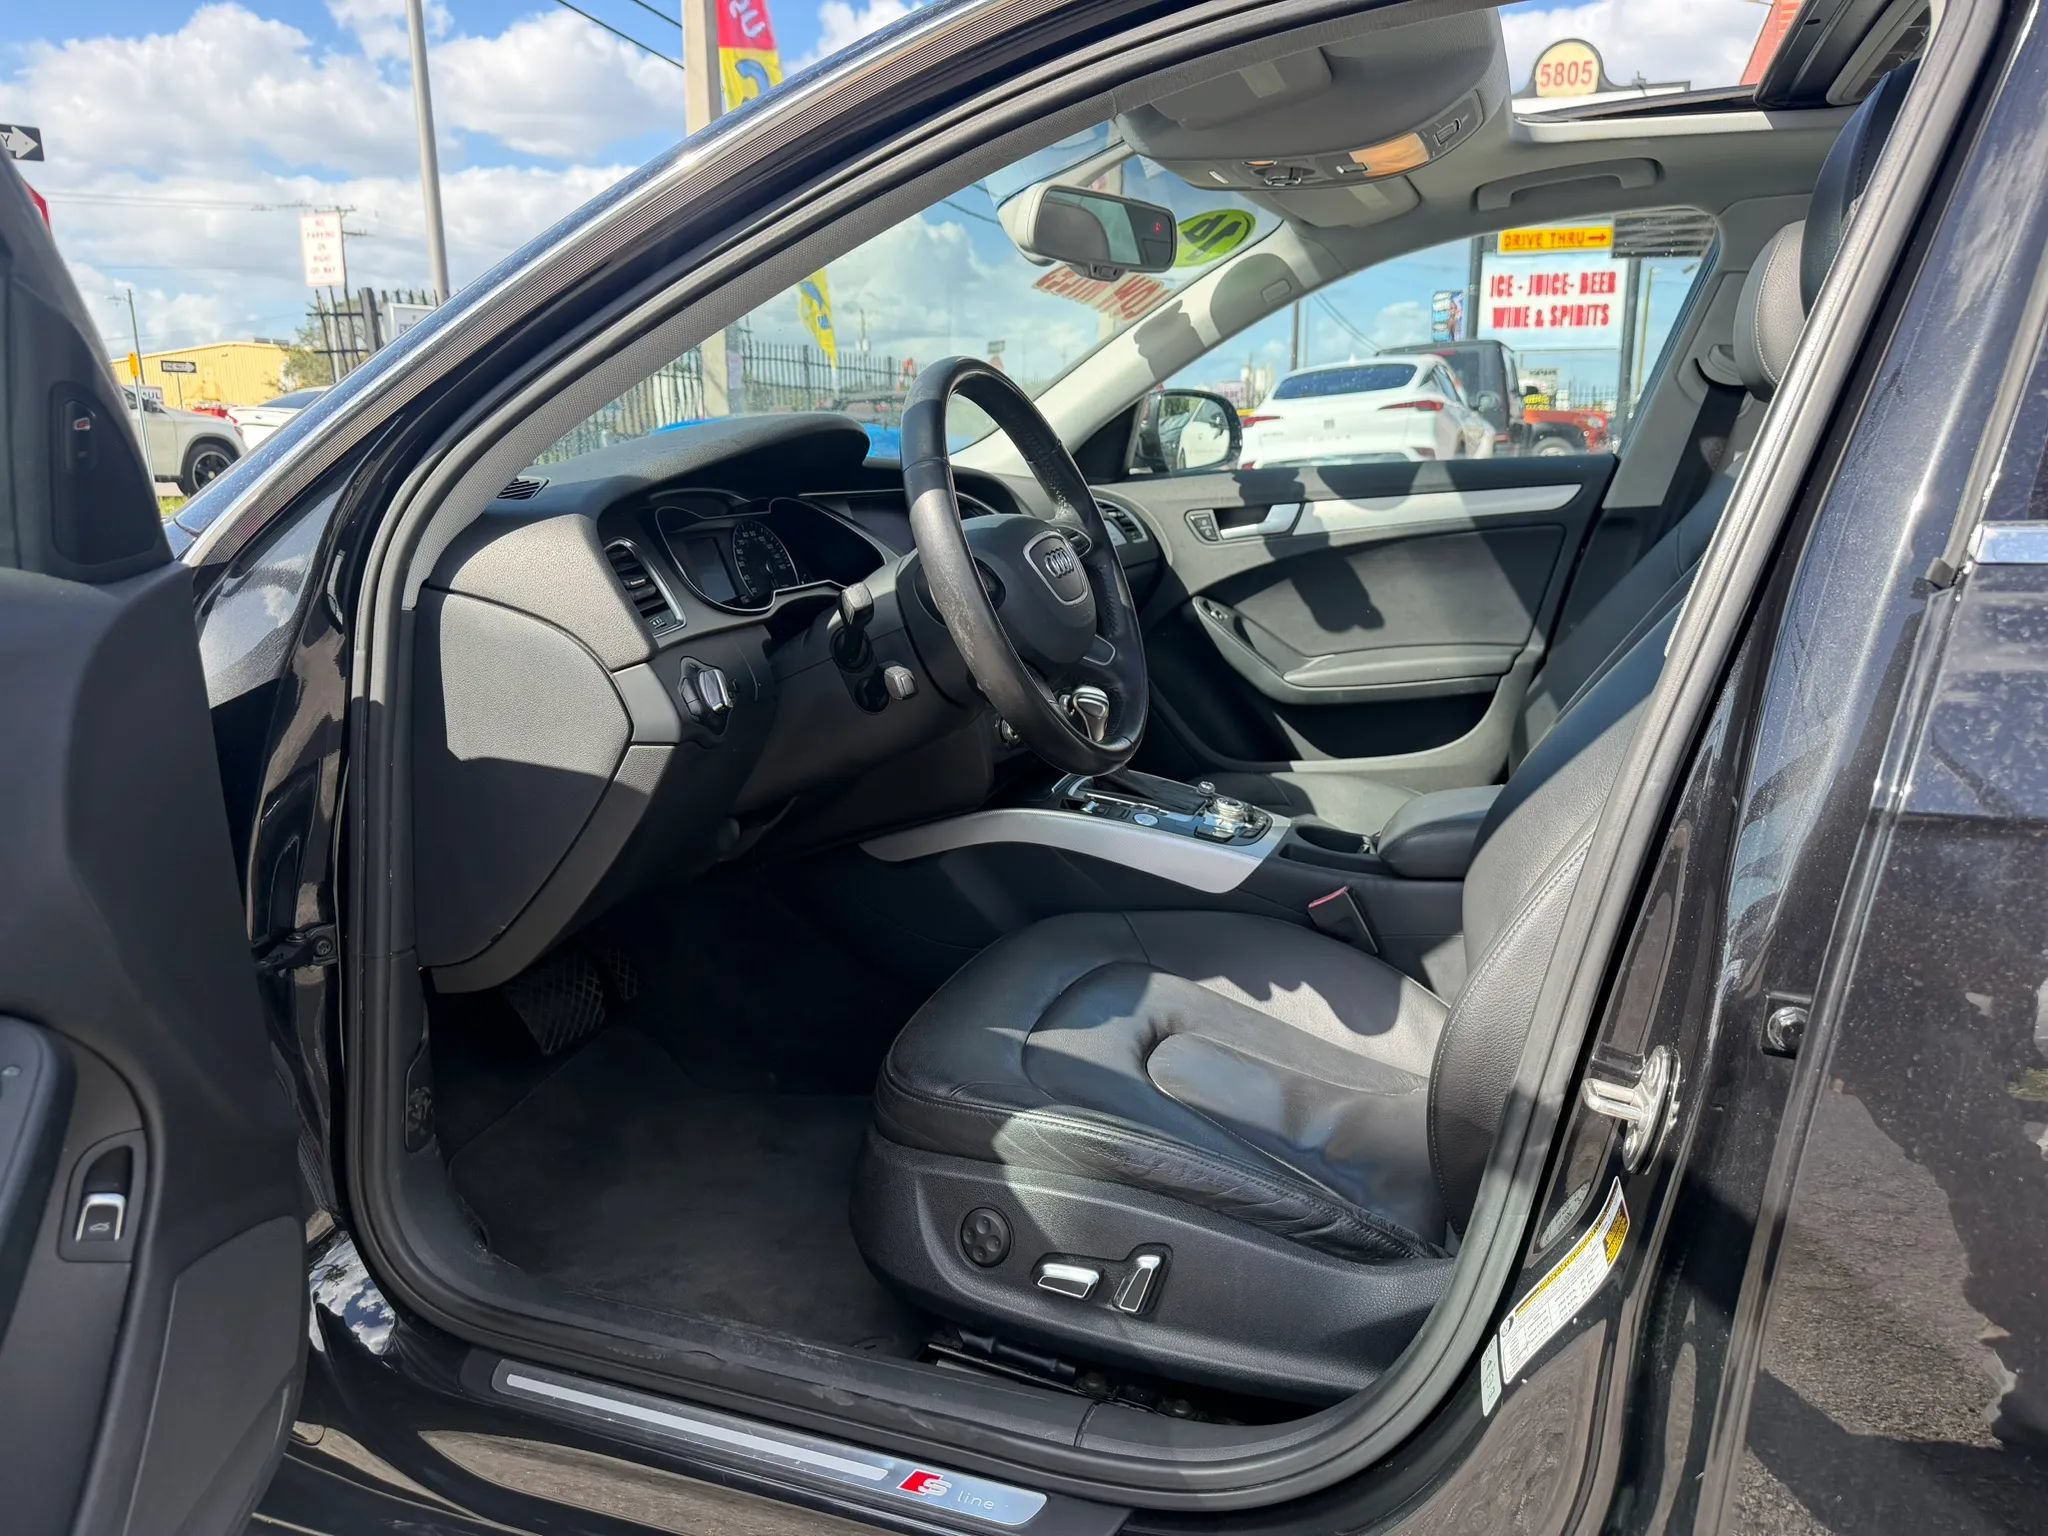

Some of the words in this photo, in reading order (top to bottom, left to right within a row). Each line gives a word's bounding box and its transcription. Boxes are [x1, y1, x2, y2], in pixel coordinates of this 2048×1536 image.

[1539, 60, 1594, 88] 5805
[1503, 232, 1544, 248] DRIVE
[1550, 231, 1586, 247] THRU
[1490, 275, 1513, 297] ICE
[1580, 271, 1616, 294] BEER
[1493, 306, 1531, 328] WINE
[1535, 308, 1545, 328] &
[1550, 303, 1609, 327] SPIRITS
[957, 1490, 994, 1510] line
